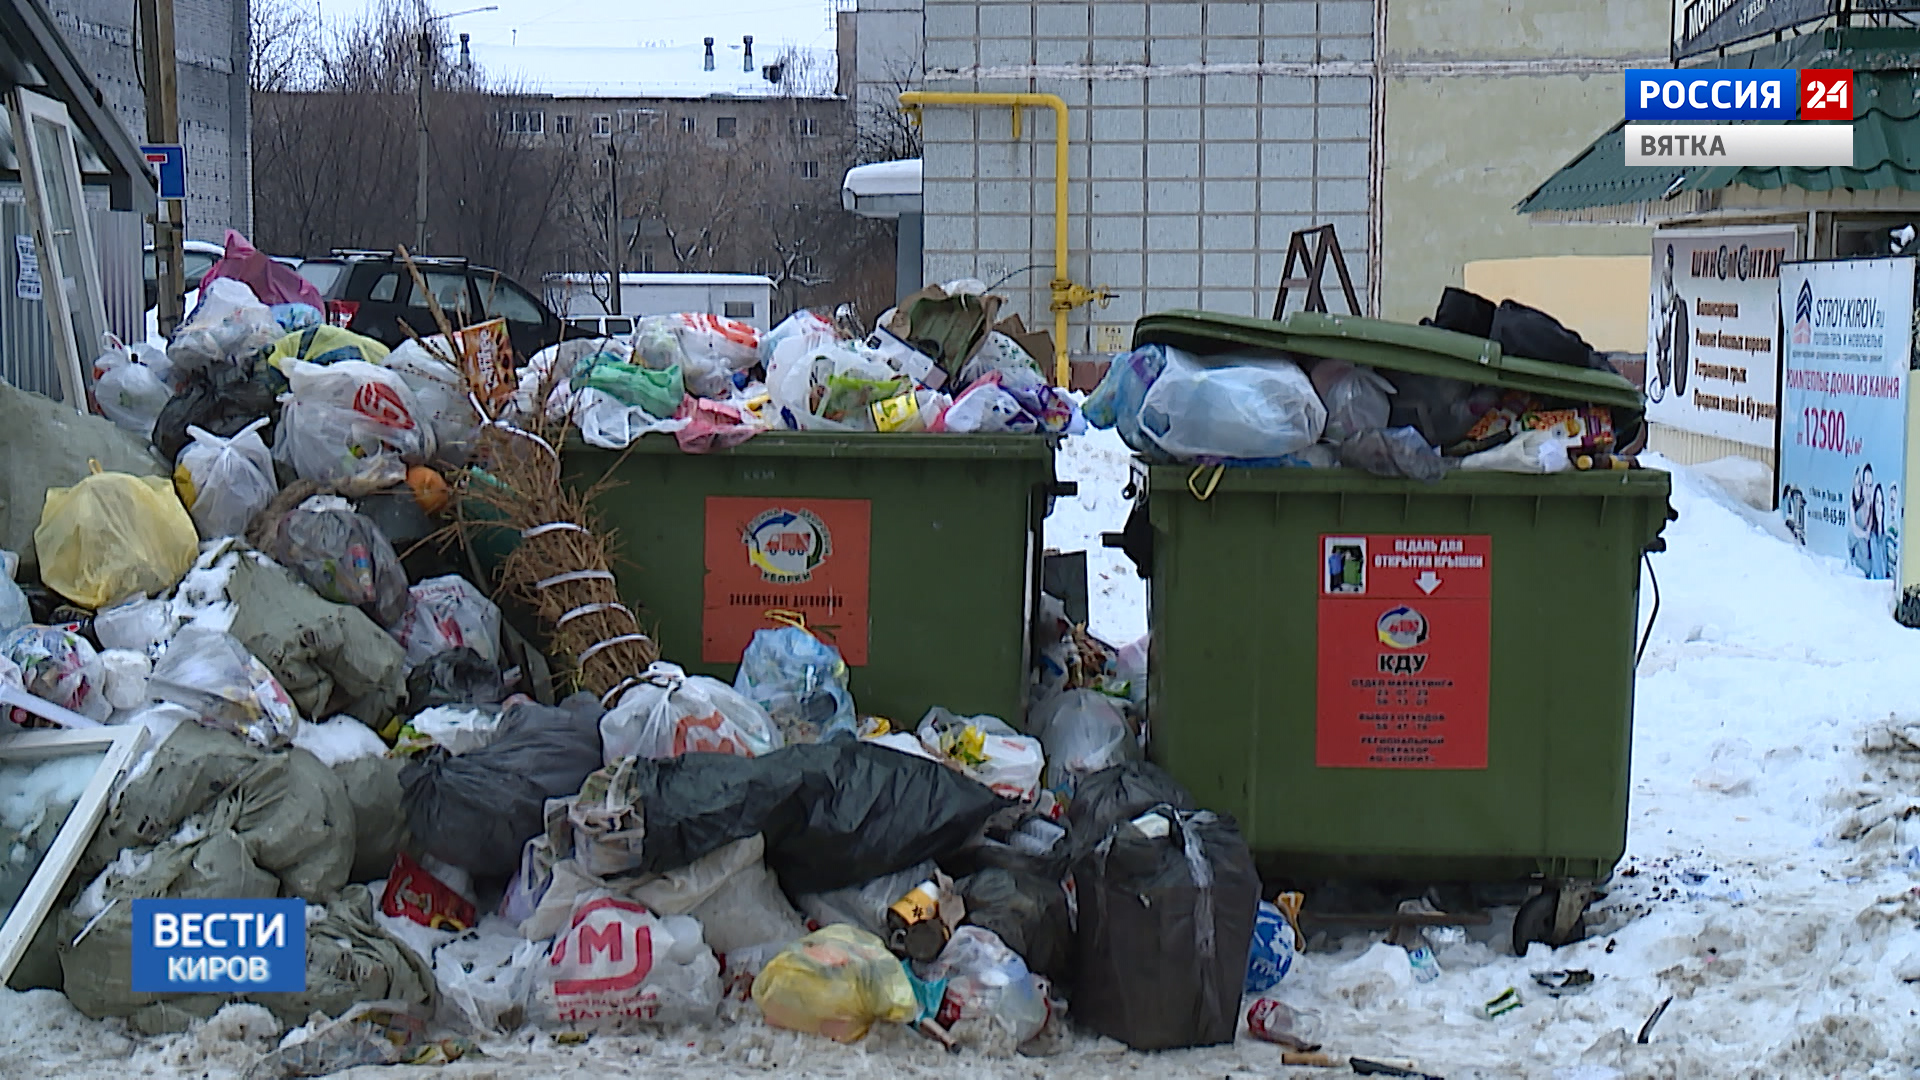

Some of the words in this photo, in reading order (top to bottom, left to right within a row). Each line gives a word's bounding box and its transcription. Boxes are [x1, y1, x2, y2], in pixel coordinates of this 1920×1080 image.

[1830, 371, 1855, 397] ДОМА
[1857, 373, 1868, 396] ИЗ
[1869, 375, 1900, 399] КАМНЯ
[1804, 407, 1845, 452] 12500
[1394, 539, 1438, 553] ПЕДАЛЬ
[1440, 540, 1463, 554] ДЛЯ
[1434, 555, 1483, 568] КРЫШКИ
[793, 595, 843, 608] ДОГОВОРОВ
[1379, 655, 1426, 674] КДУ
